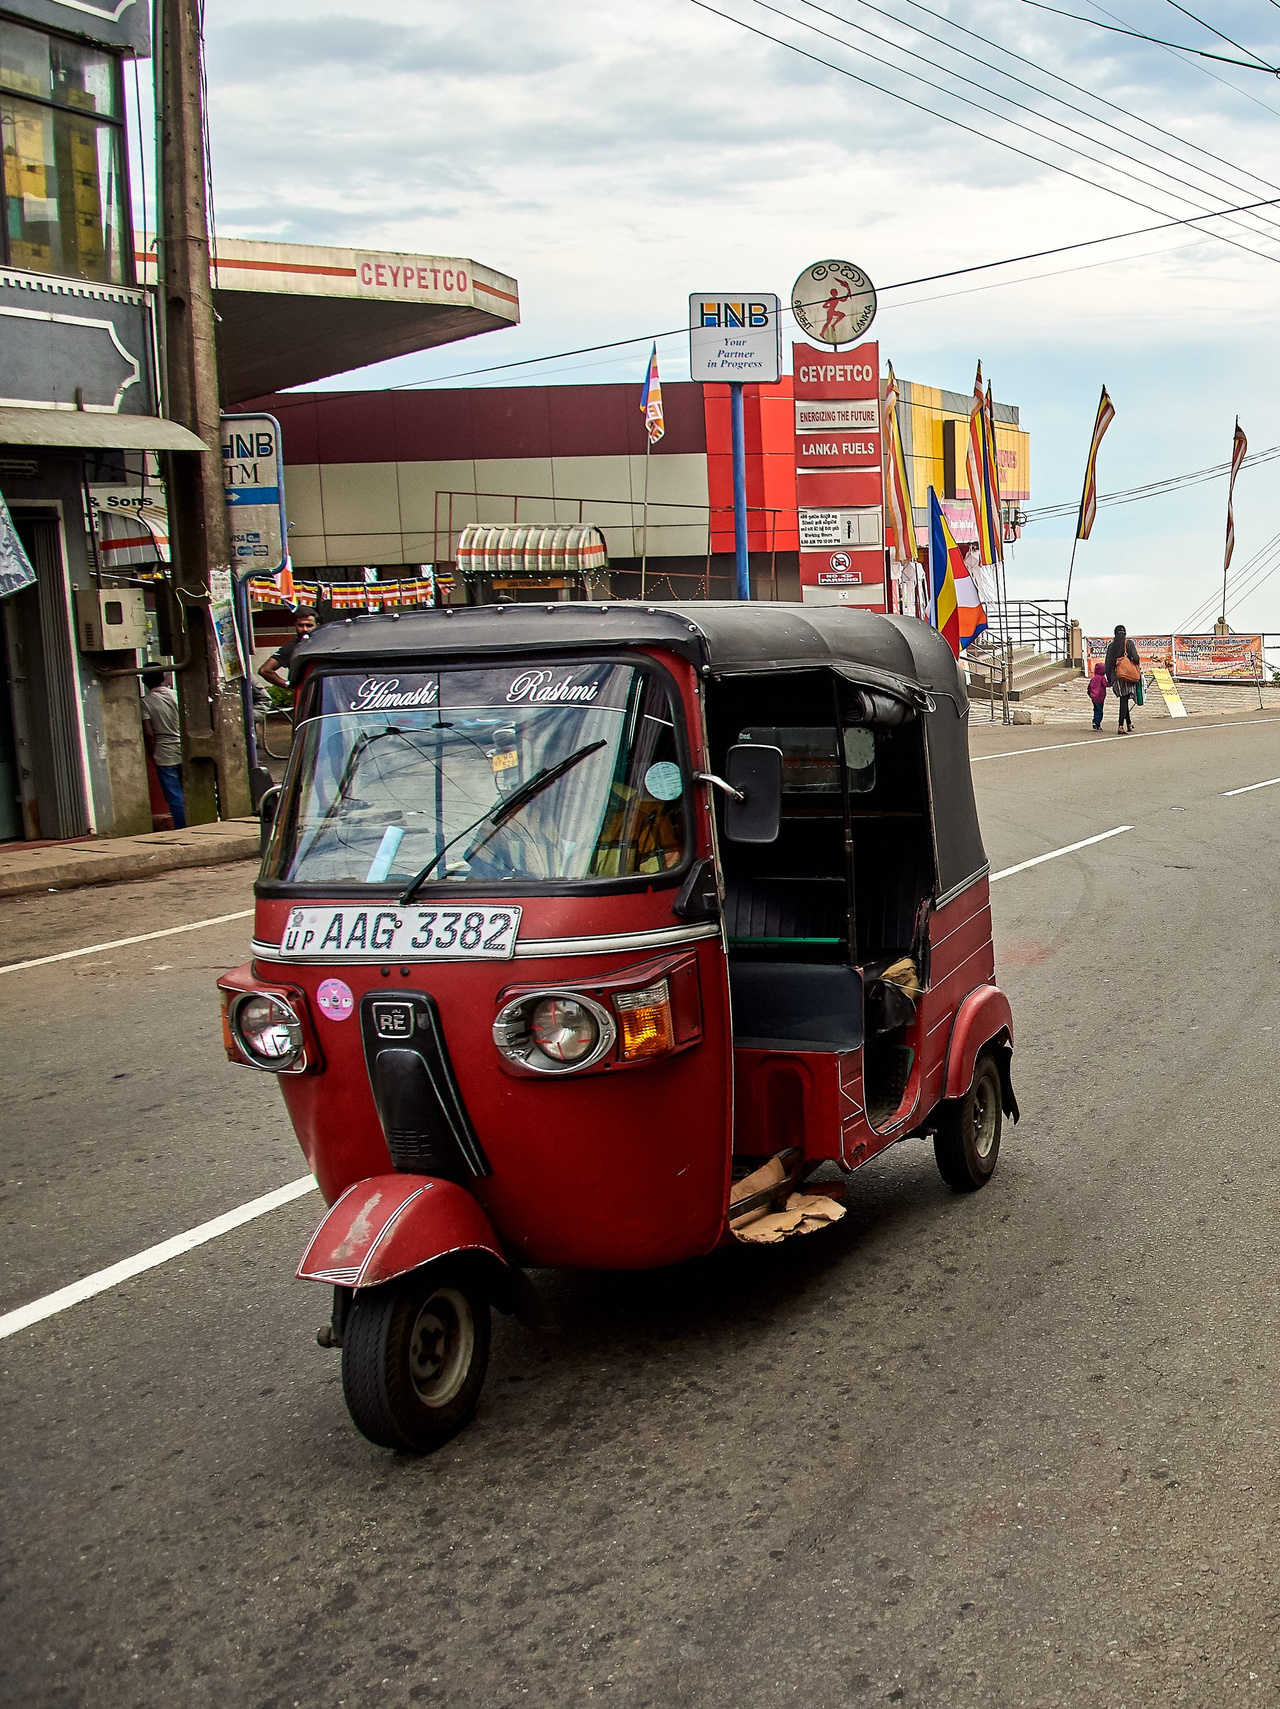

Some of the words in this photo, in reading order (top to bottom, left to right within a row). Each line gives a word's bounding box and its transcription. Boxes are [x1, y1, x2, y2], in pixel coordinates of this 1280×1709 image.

[360, 262, 468, 293] CEYPETCO
[700, 302, 770, 328] HNB
[851, 304, 873, 334] LANKA
[724, 337, 748, 347] Your
[717, 350, 754, 359] Partner
[707, 360, 718, 368] in
[720, 360, 763, 370] Progress
[800, 365, 873, 383] CEYPETCO
[800, 411, 836, 423] ENERGIZING
[837, 411, 850, 421] THE
[850, 410, 875, 422] FUTURE
[802, 443, 839, 456] LANKA
[842, 442, 875, 455] FUELS
[223, 462, 261, 485] TM
[107, 496, 154, 506] Sons
[505, 670, 599, 702] Rashmi
[287, 929, 315, 950] UP
[320, 912, 397, 949] AAG
[411, 912, 512, 950] 3382
[380, 1014, 407, 1031] RE
